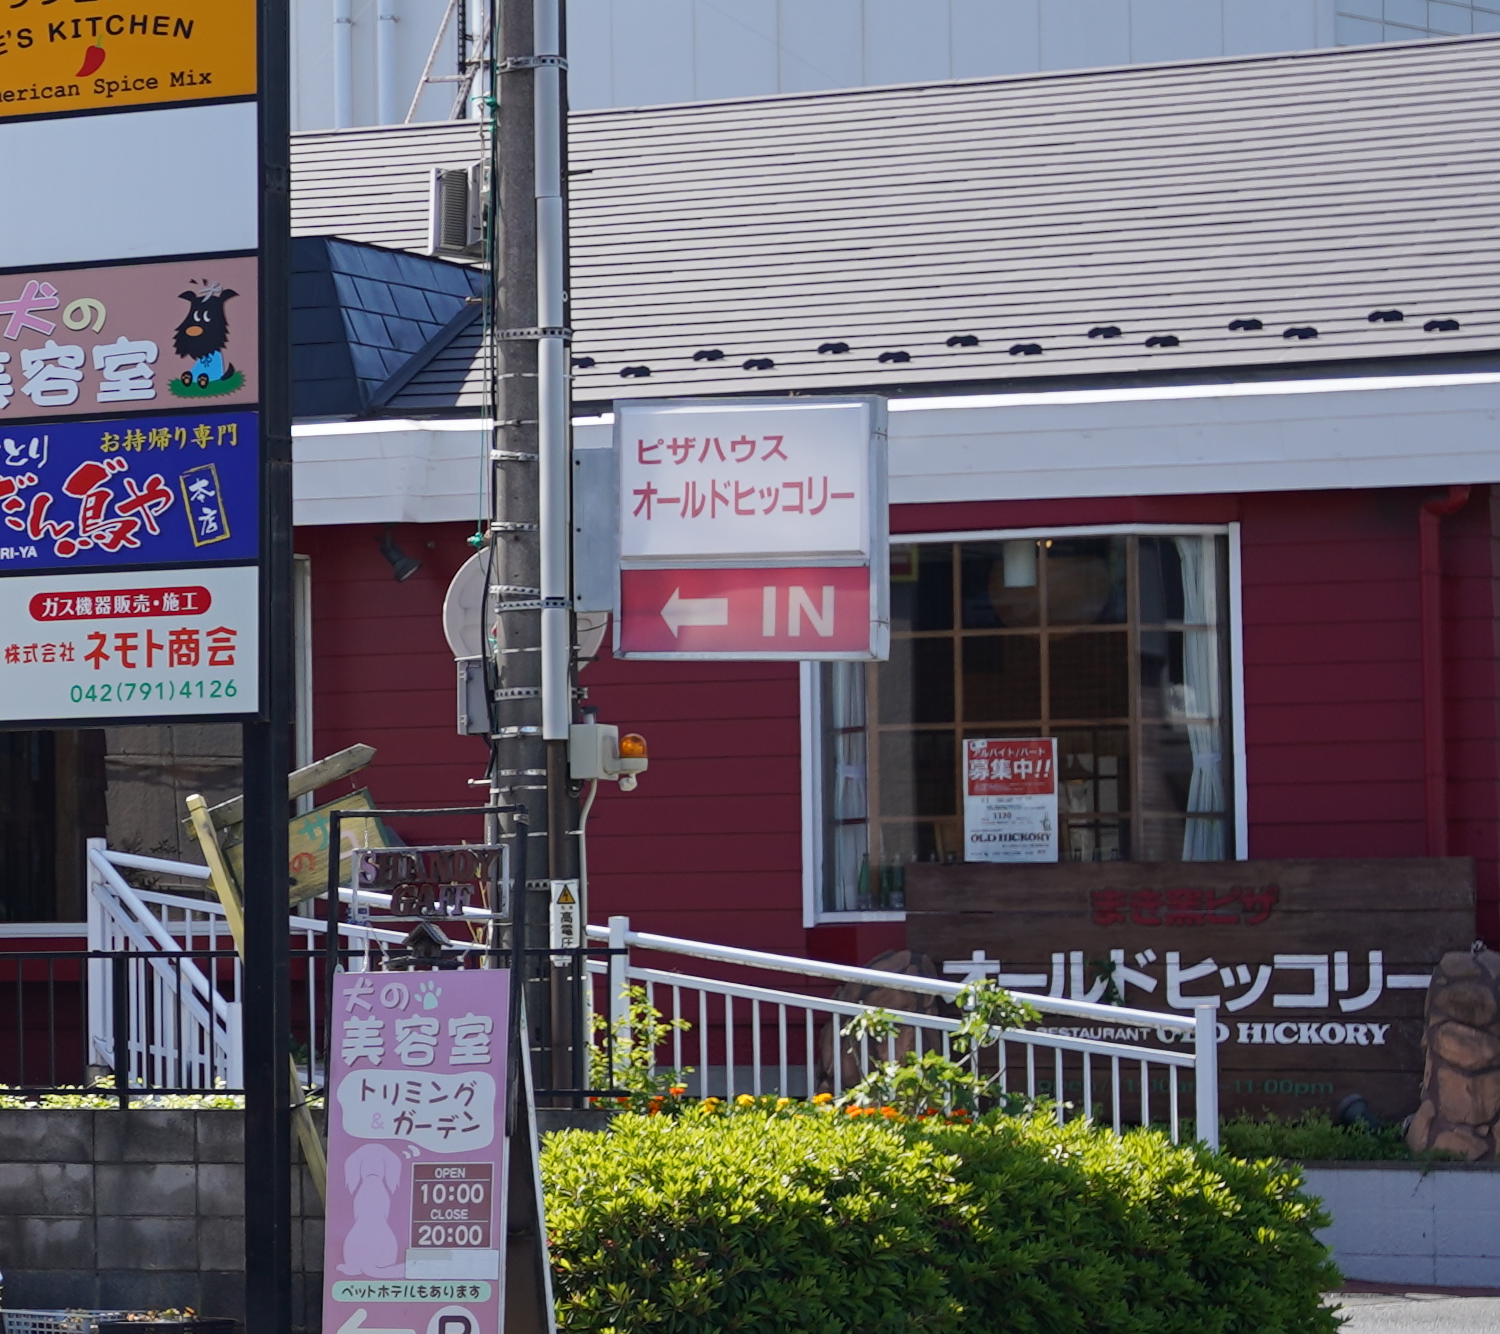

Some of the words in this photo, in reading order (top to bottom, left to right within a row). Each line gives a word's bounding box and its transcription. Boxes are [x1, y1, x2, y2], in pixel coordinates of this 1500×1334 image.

[48, 14, 195, 41] KITCHEN
[93, 74, 159, 98] Spice
[170, 70, 213, 88] Mix
[100, 423, 238, 453] お持帰り専門
[637, 434, 788, 465] ピザハウス
[632, 475, 855, 520] オールドヒッコリー
[41, 592, 199, 618] ガス機器販売・施工
[762, 586, 836, 637] IN
[4, 641, 75, 665] 株式会社
[84, 625, 238, 670] ネモト商会
[70, 679, 238, 704] 042(791)4126
[969, 758, 1051, 781] 募集中!!
[342, 978, 410, 1014] 犬の
[341, 1012, 494, 1067] 美容室
[1237, 1022, 1390, 1046] HICKORY
[360, 1078, 478, 1107] トリミング
[371, 1112, 384, 1131] &
[392, 1108, 481, 1138] ガーデン
[434, 1167, 466, 1179] OPEN
[420, 1183, 484, 1204] 10:00
[430, 1209, 469, 1220] CLOSE
[418, 1225, 483, 1245] 20:00
[341, 1283, 481, 1301] ペットホテルもあります
